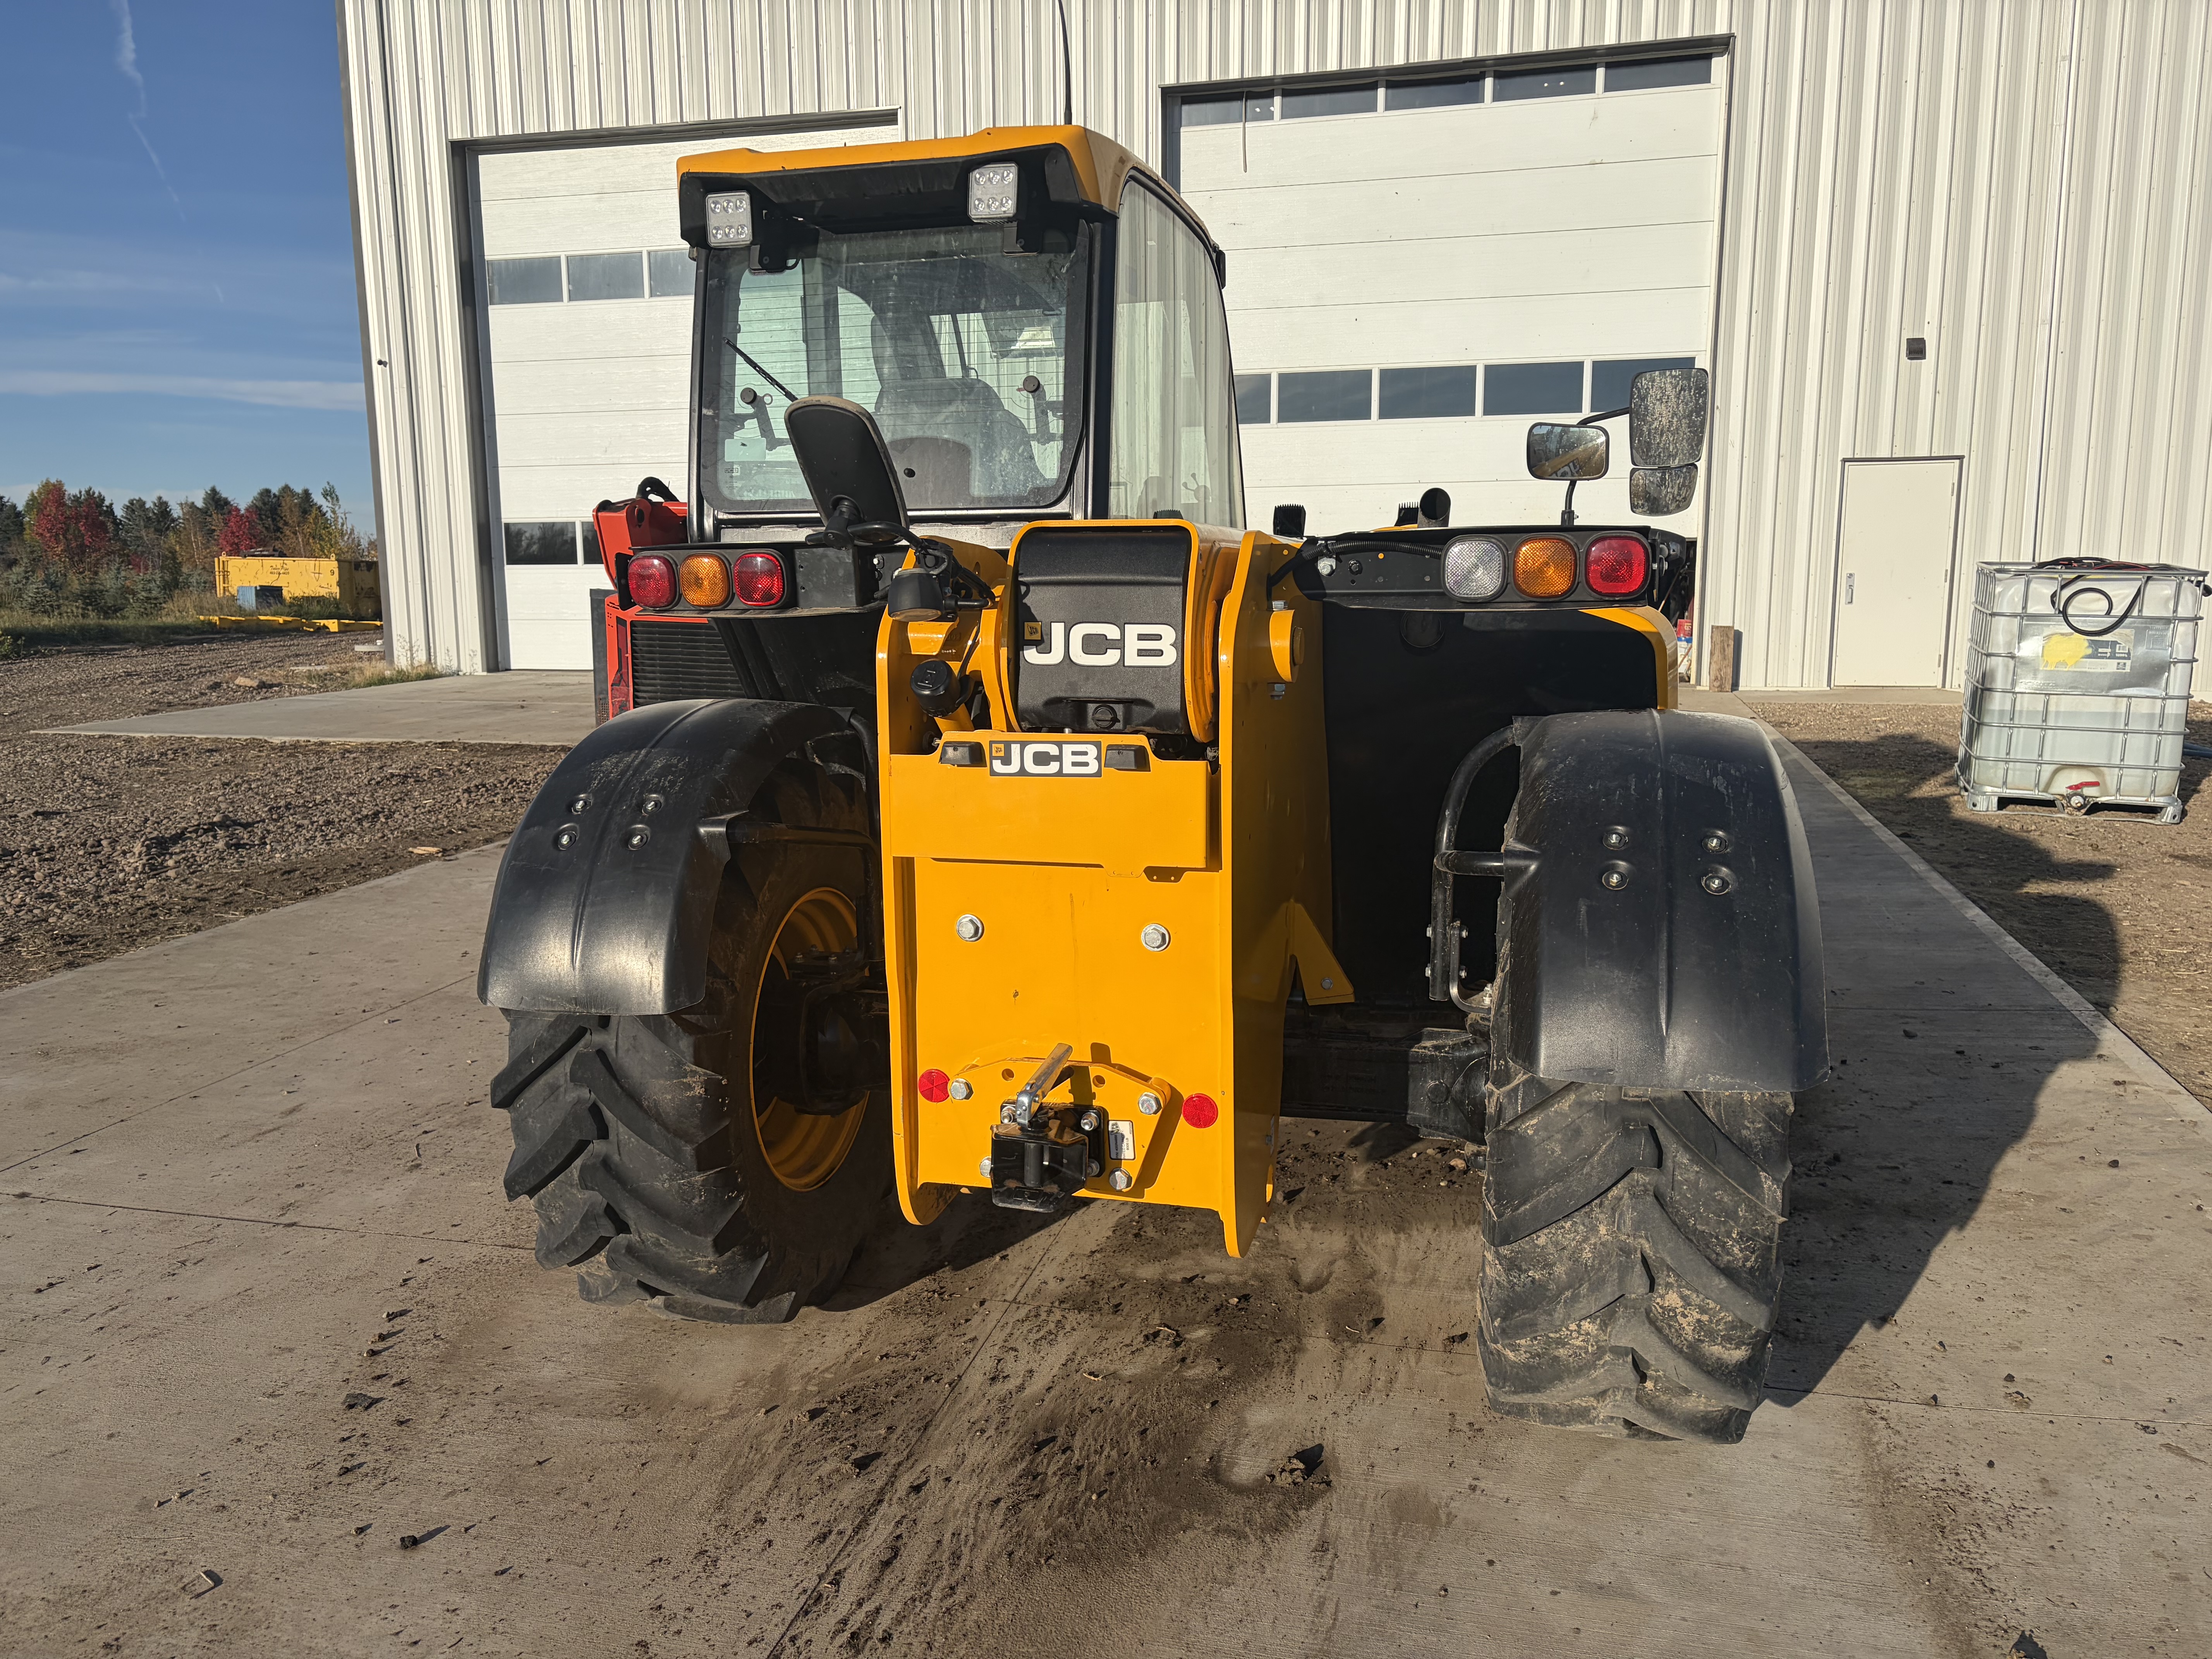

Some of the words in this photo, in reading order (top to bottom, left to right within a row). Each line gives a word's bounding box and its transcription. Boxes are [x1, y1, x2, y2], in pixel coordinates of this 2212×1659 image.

[1029, 627, 1038, 635] JCB
[1024, 622, 1177, 666] JCB
[992, 744, 1099, 774] JCB
[1111, 1123, 1120, 1133] JCB
